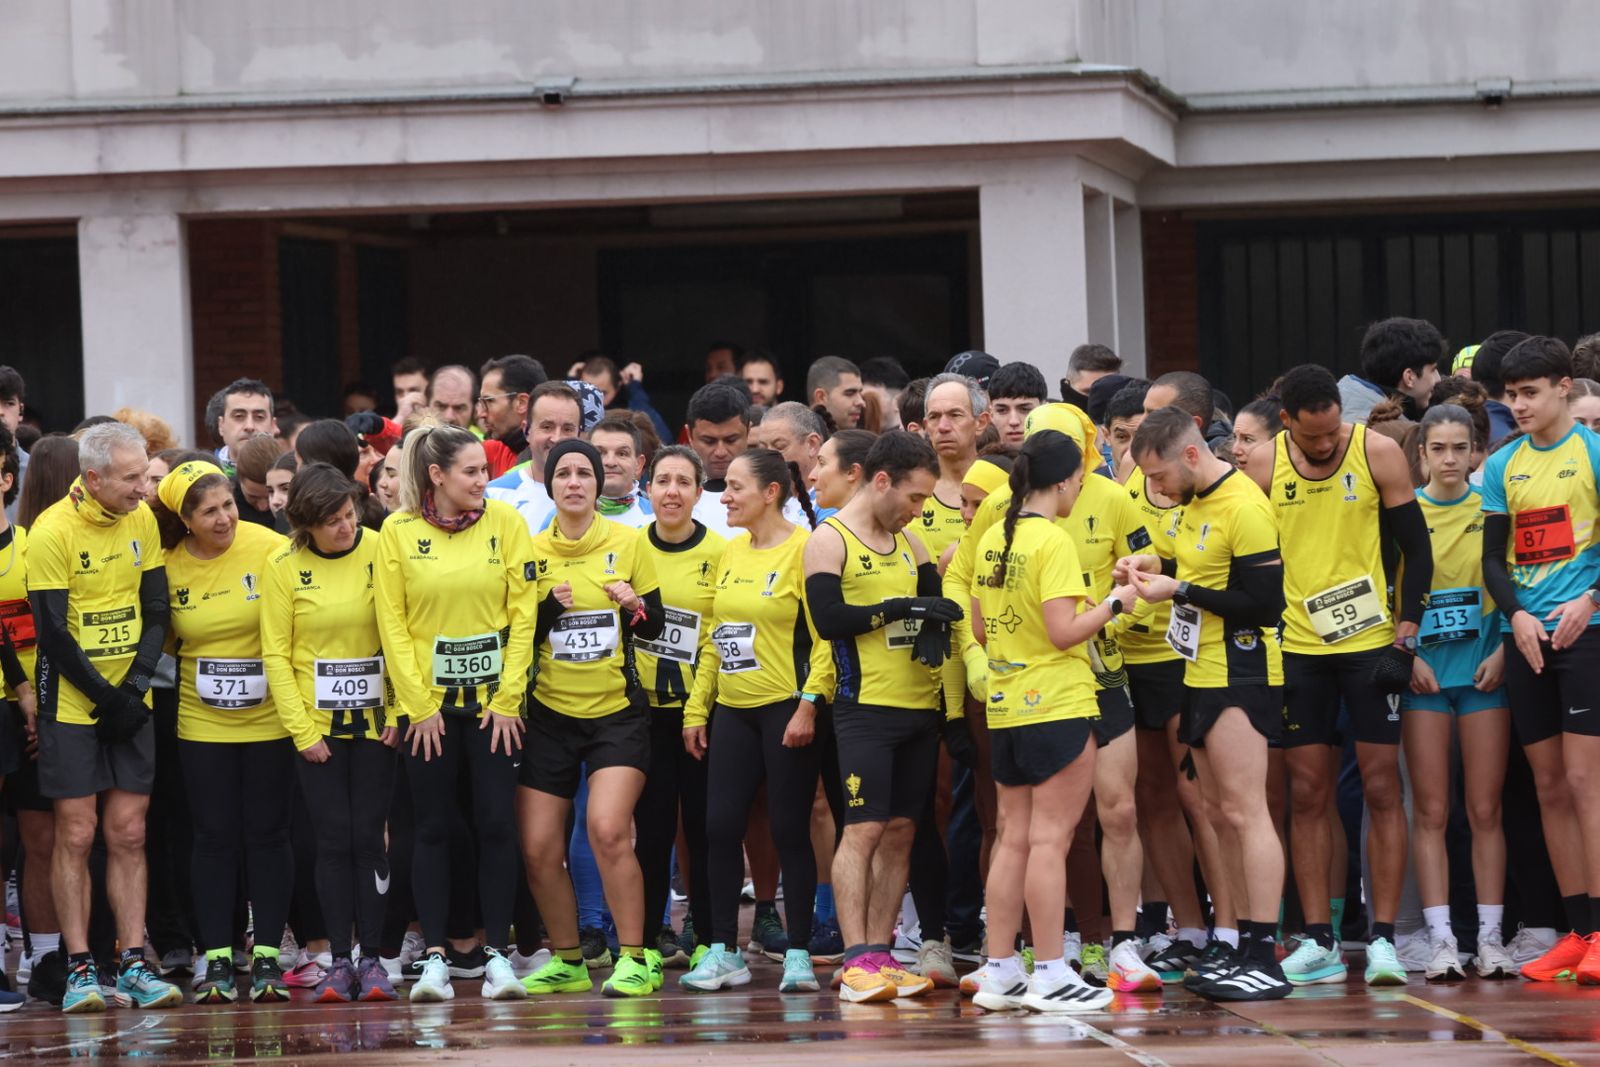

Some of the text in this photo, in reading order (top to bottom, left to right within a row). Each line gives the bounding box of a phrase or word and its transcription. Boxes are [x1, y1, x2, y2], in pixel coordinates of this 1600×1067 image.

[1524, 529, 1545, 547] 87
[1332, 604, 1357, 625] 59
[1432, 609, 1468, 629] 153
[98, 625, 130, 644] 215
[564, 632, 601, 649] 431
[658, 626, 681, 644] 10
[1174, 622, 1190, 641] 78
[444, 656, 492, 674] 1360
[213, 679, 249, 695] 371
[332, 679, 368, 696] 409
[849, 798, 864, 807] GCB
